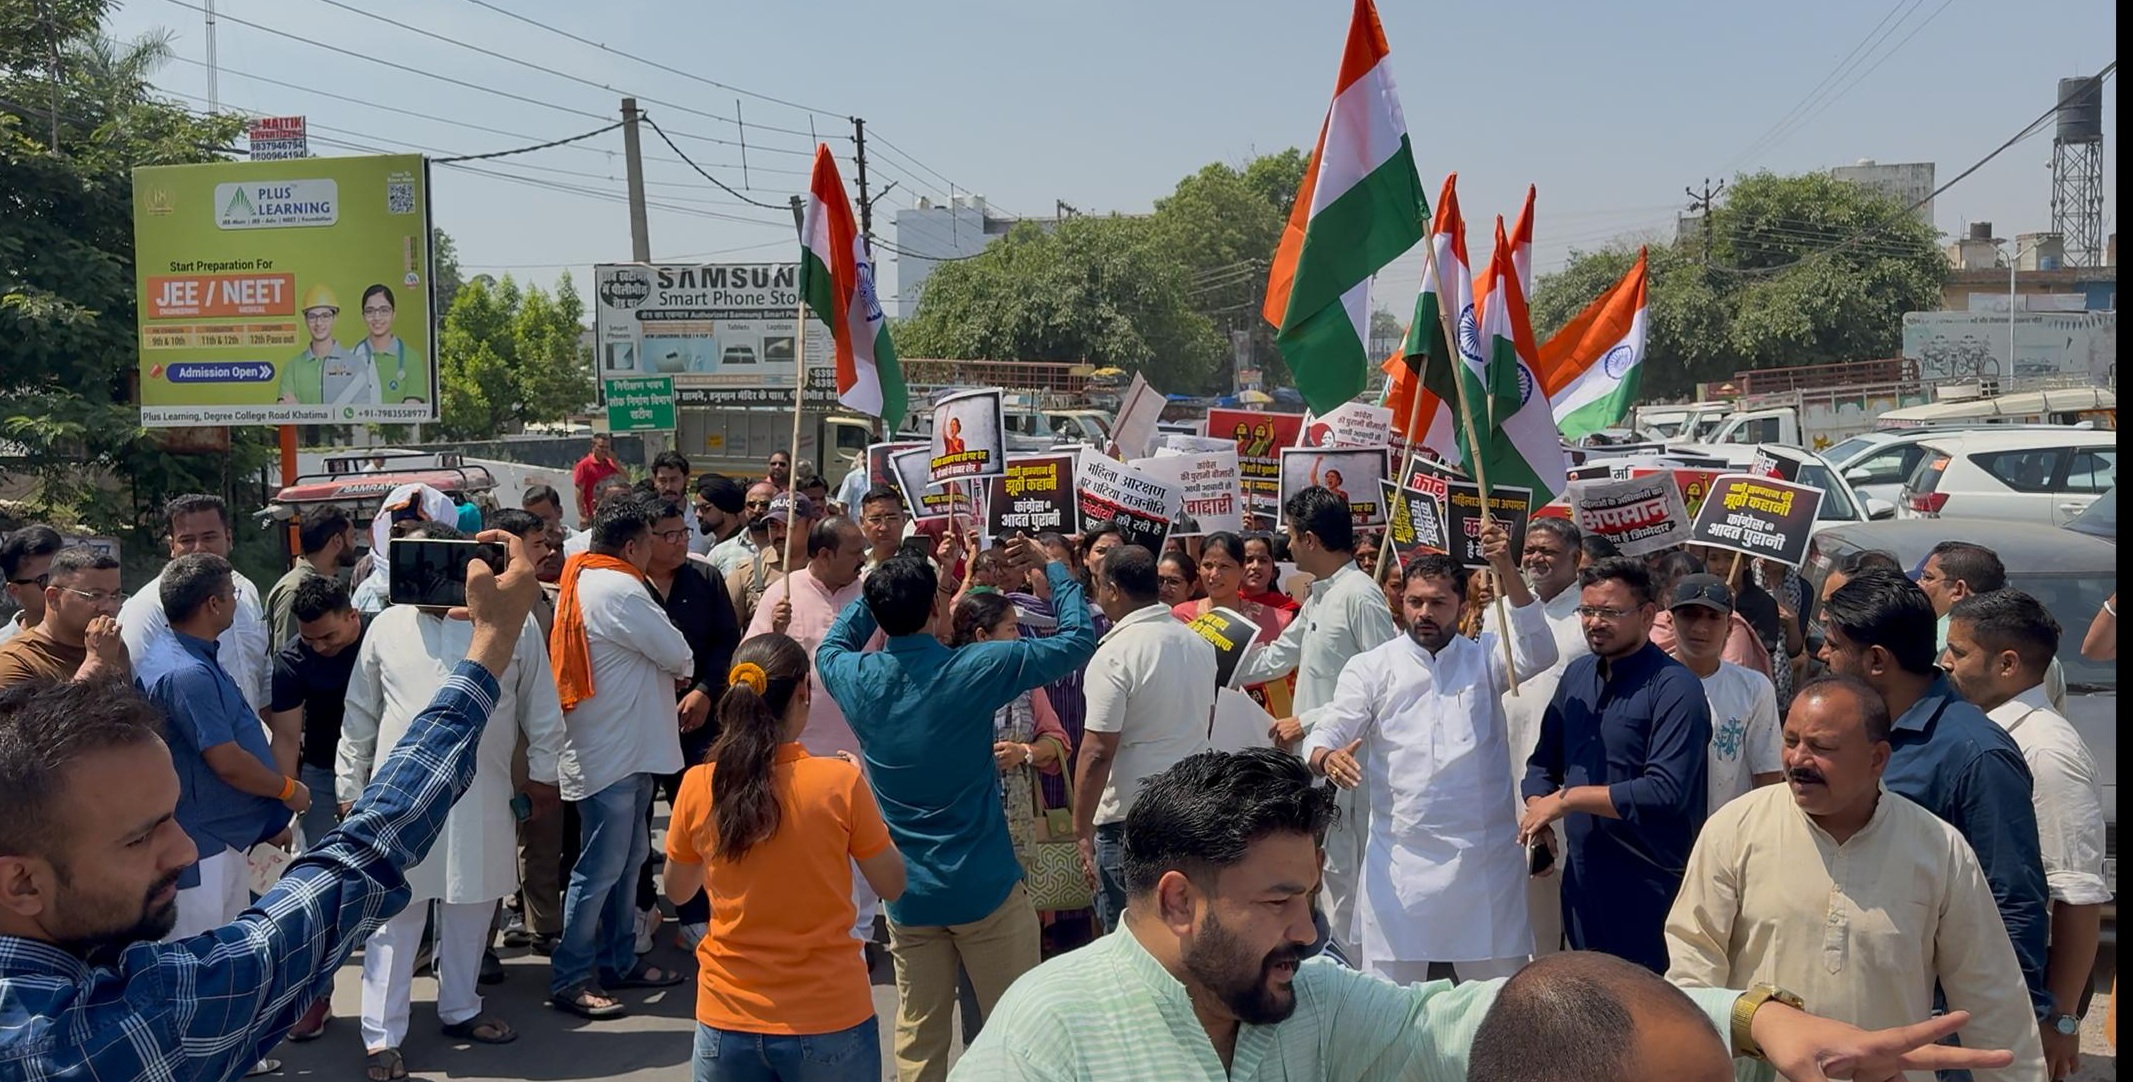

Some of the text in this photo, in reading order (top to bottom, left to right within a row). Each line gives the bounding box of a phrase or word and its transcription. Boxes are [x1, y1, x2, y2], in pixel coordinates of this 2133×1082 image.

[262, 116, 301, 129] NAITIK
[258, 187, 291, 200] PLUS
[259, 202, 330, 215] LEARNING
[170, 258, 273, 273] Start Preparation For
[657, 267, 795, 289] SAMSUN
[156, 281, 199, 306] JEE
[222, 278, 285, 305] NEET
[659, 290, 797, 306] Smart Phone Sto
[691, 311, 728, 319] Authorized
[730, 311, 762, 320] Samsung
[764, 311, 784, 319] Smart
[766, 323, 792, 331] Laptops
[171, 336, 186, 345] 10th
[202, 336, 216, 345] 11th
[224, 335, 239, 344] 12th
[179, 366, 258, 379] Admission Open
[143, 409, 328, 422] Plus Learning, Degree College Road Khatima
[1088, 462, 1167, 499] महिला आरक्षण
[1180, 472, 1190, 481] की
[1190, 470, 1210, 483] पुरानी
[1212, 467, 1234, 479] बीमारी
[1005, 475, 1057, 496] झूठी कहानी
[1081, 477, 1092, 489] पर
[1093, 481, 1120, 500] घटिया
[1123, 493, 1166, 515] राजनीति
[1186, 492, 1234, 516] गद्दारी
[1451, 492, 1486, 508] महिला
[1501, 499, 1527, 511] अपमान
[1723, 492, 1791, 516] झूठी कहानी
[1013, 498, 1045, 514] कांग्रेस
[1582, 497, 1669, 530] अपमान
[1001, 513, 1030, 528] आदत
[1030, 508, 1060, 532] पुरानी
[1116, 514, 1131, 527] की
[1133, 519, 1150, 533] रही
[1152, 522, 1162, 535] है
[1727, 512, 1765, 531] कांग्रेस
[1708, 523, 1786, 551] आदत पुरानी
